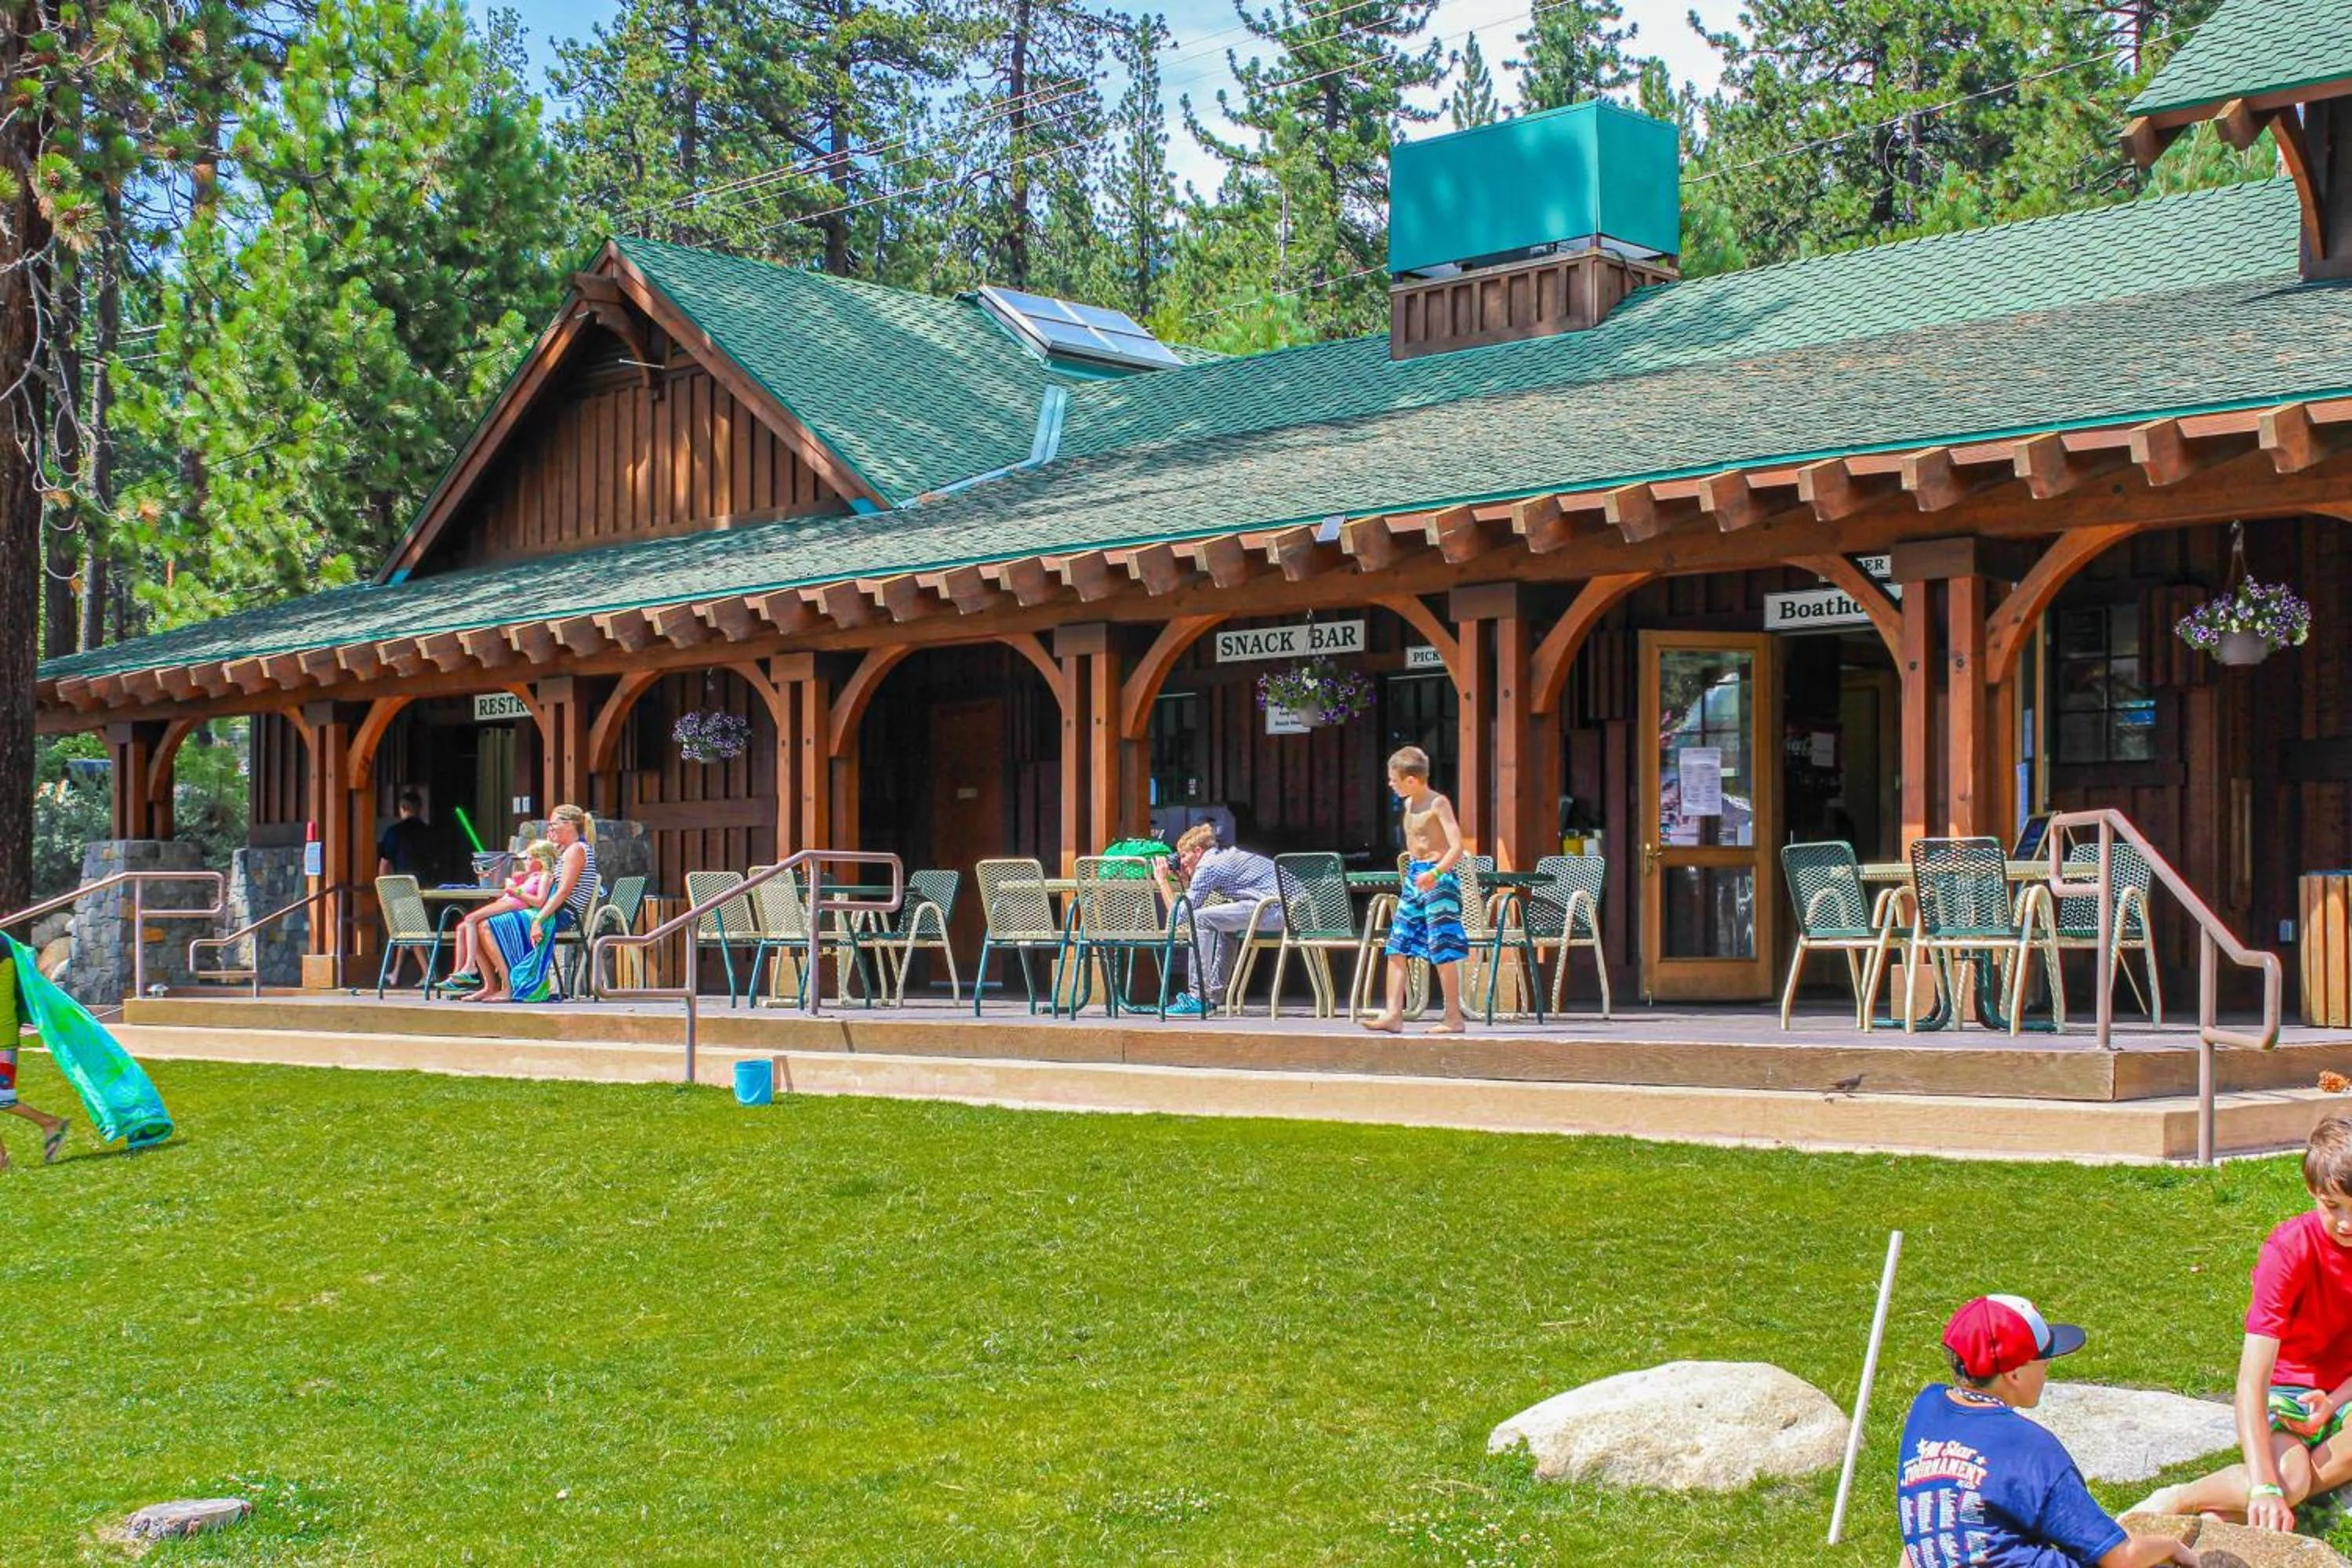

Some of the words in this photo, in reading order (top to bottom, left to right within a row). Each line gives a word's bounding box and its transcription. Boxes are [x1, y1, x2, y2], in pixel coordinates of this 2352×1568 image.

[1858, 558, 1885, 570] ER
[1221, 631, 1295, 656] SNACK
[1310, 626, 1357, 649] BAR
